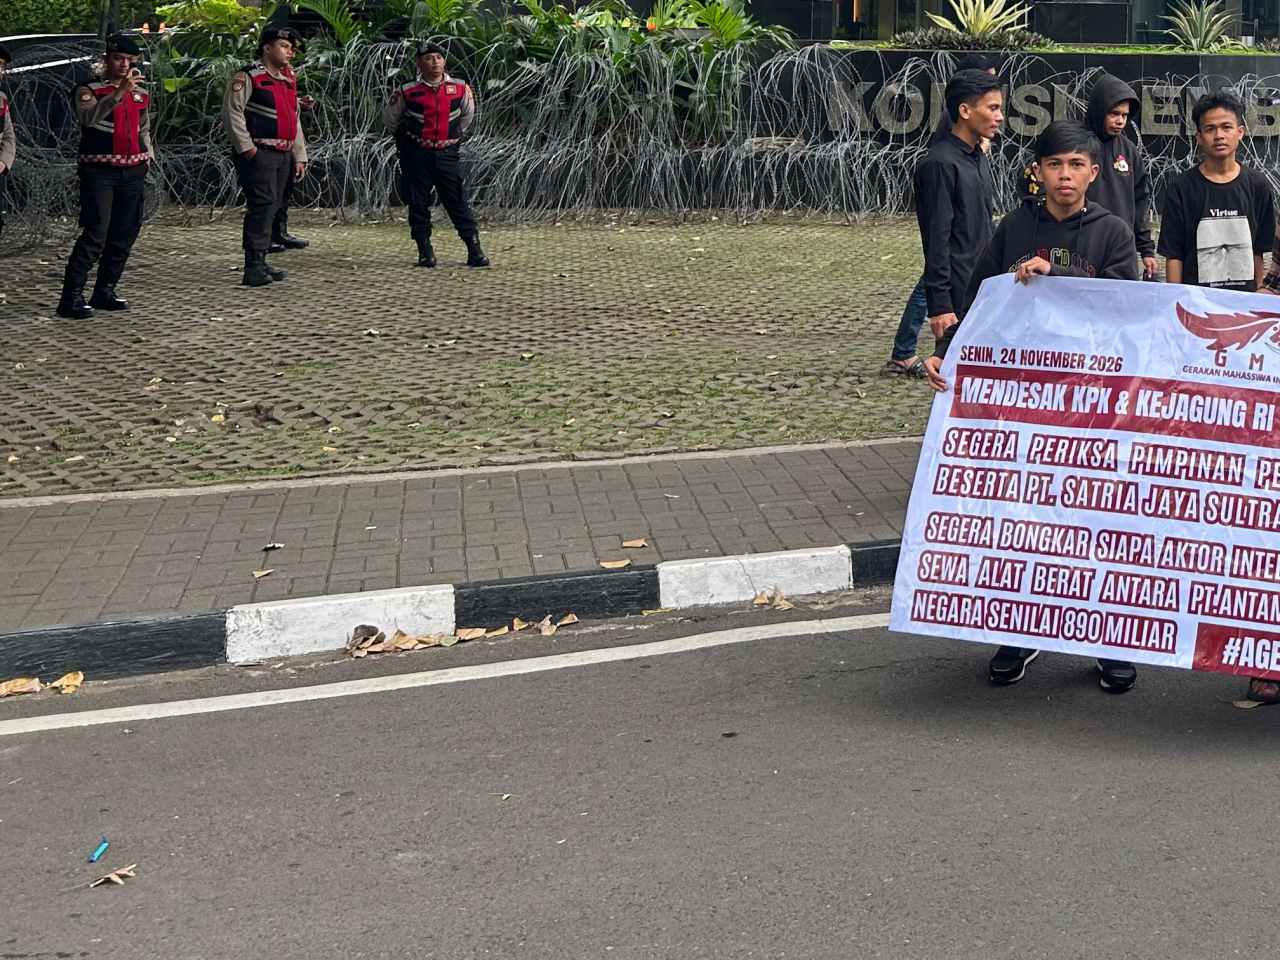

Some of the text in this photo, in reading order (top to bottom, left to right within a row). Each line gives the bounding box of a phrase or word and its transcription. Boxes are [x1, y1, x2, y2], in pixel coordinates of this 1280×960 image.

[1209, 208, 1238, 217] Virtue
[960, 345, 1124, 373] SENIN, 24 NOVEMBER 2026
[1182, 365, 1220, 377] GERAKAN
[961, 376, 1275, 432] MENDESAK KPK & KEJAGUNG RI
[944, 429, 1017, 460] SEGERA
[1030, 435, 1118, 469] PERIKSA
[1132, 447, 1244, 484] PIMPINAN
[935, 467, 1019, 499] BESERTA
[1025, 474, 1055, 504] PT.
[1062, 479, 1137, 512] SATRIA
[1144, 487, 1199, 519] JAYA
[926, 515, 992, 544] SEGERA
[1000, 521, 1090, 558] BONGKAR
[1097, 532, 1152, 565] SIAPA
[1160, 539, 1224, 572] AKTOR
[919, 554, 968, 584] SEWA
[976, 560, 1025, 589] ALAT
[1034, 566, 1094, 598] BERAT
[1101, 574, 1178, 609] ANTARA
[912, 592, 1176, 651] NEGARA SENILAI 890 MILIAR
